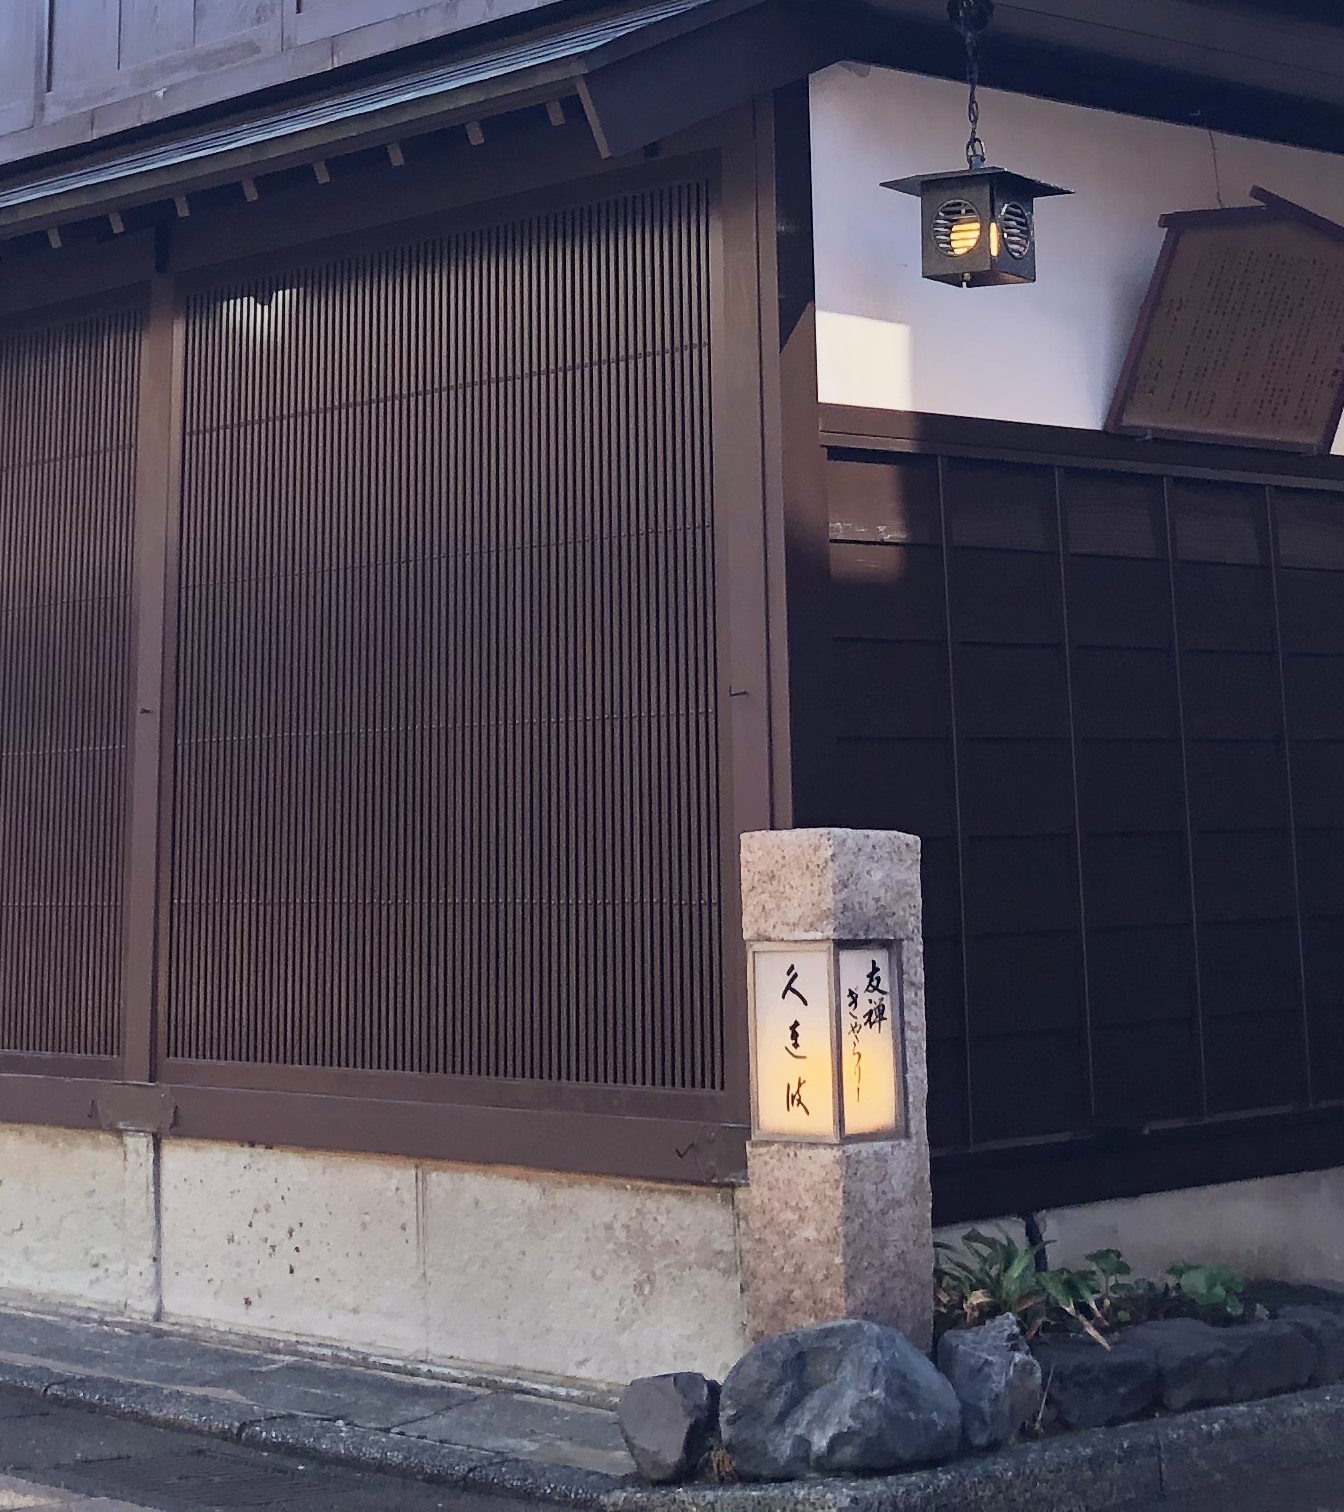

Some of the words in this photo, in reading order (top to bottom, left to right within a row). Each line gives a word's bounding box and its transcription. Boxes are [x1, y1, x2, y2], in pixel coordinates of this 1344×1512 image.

[780, 963, 810, 1116] 久連波
[862, 959, 889, 1035] 友禅
